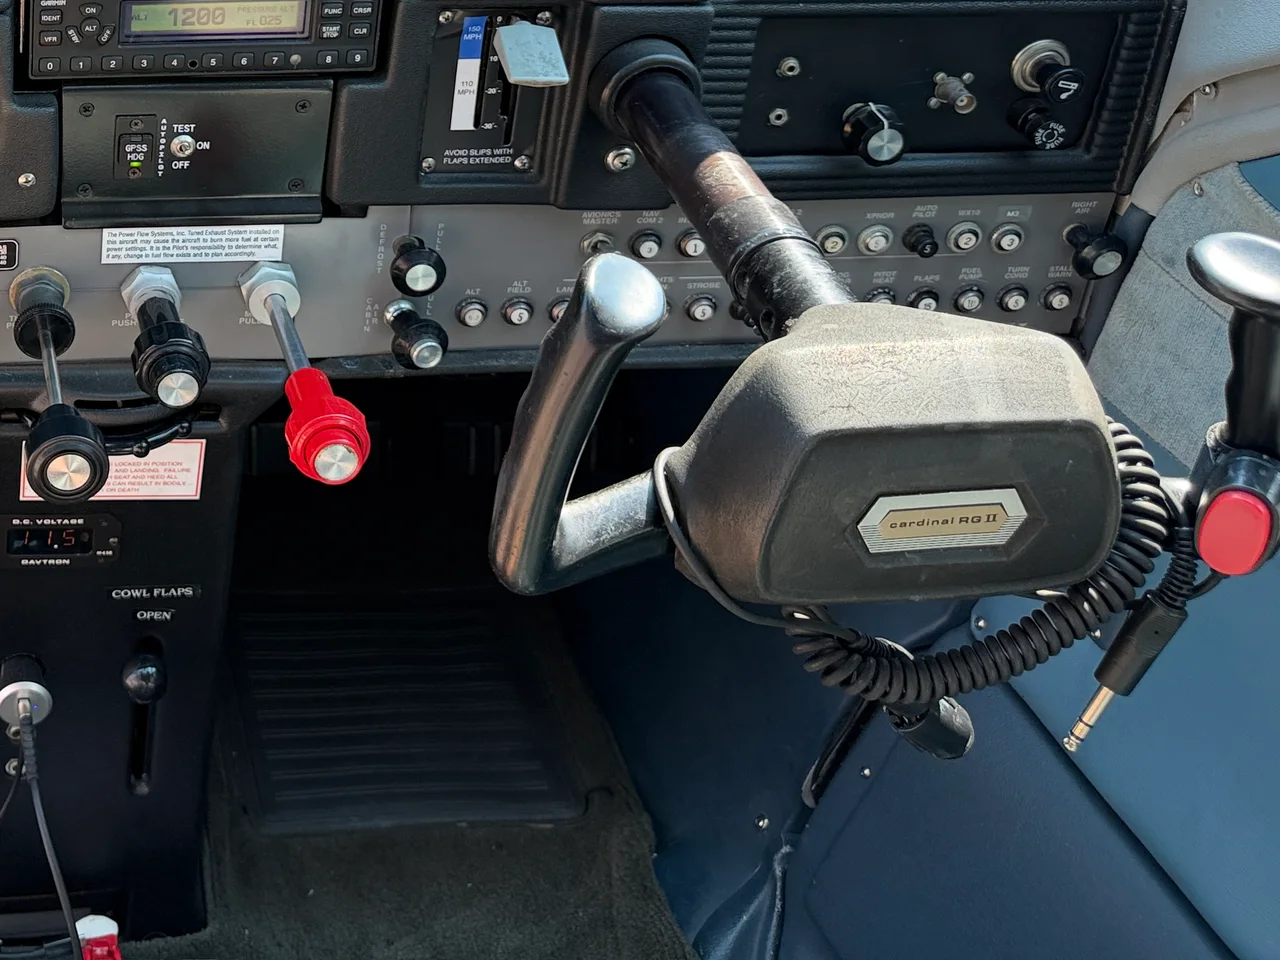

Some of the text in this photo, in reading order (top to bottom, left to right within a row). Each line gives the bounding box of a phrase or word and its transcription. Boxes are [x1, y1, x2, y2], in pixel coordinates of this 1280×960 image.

[168, 7, 226, 27] 1200
[173, 124, 196, 133] TEST
[126, 144, 148, 152] GPSS
[197, 142, 210, 150] ON
[128, 153, 144, 161] HDG
[172, 161, 190, 169] OFF
[890, 514, 998, 529] cardinal RG II
[112, 588, 193, 599] COWL FLAPS
[137, 611, 171, 620] OPEN
